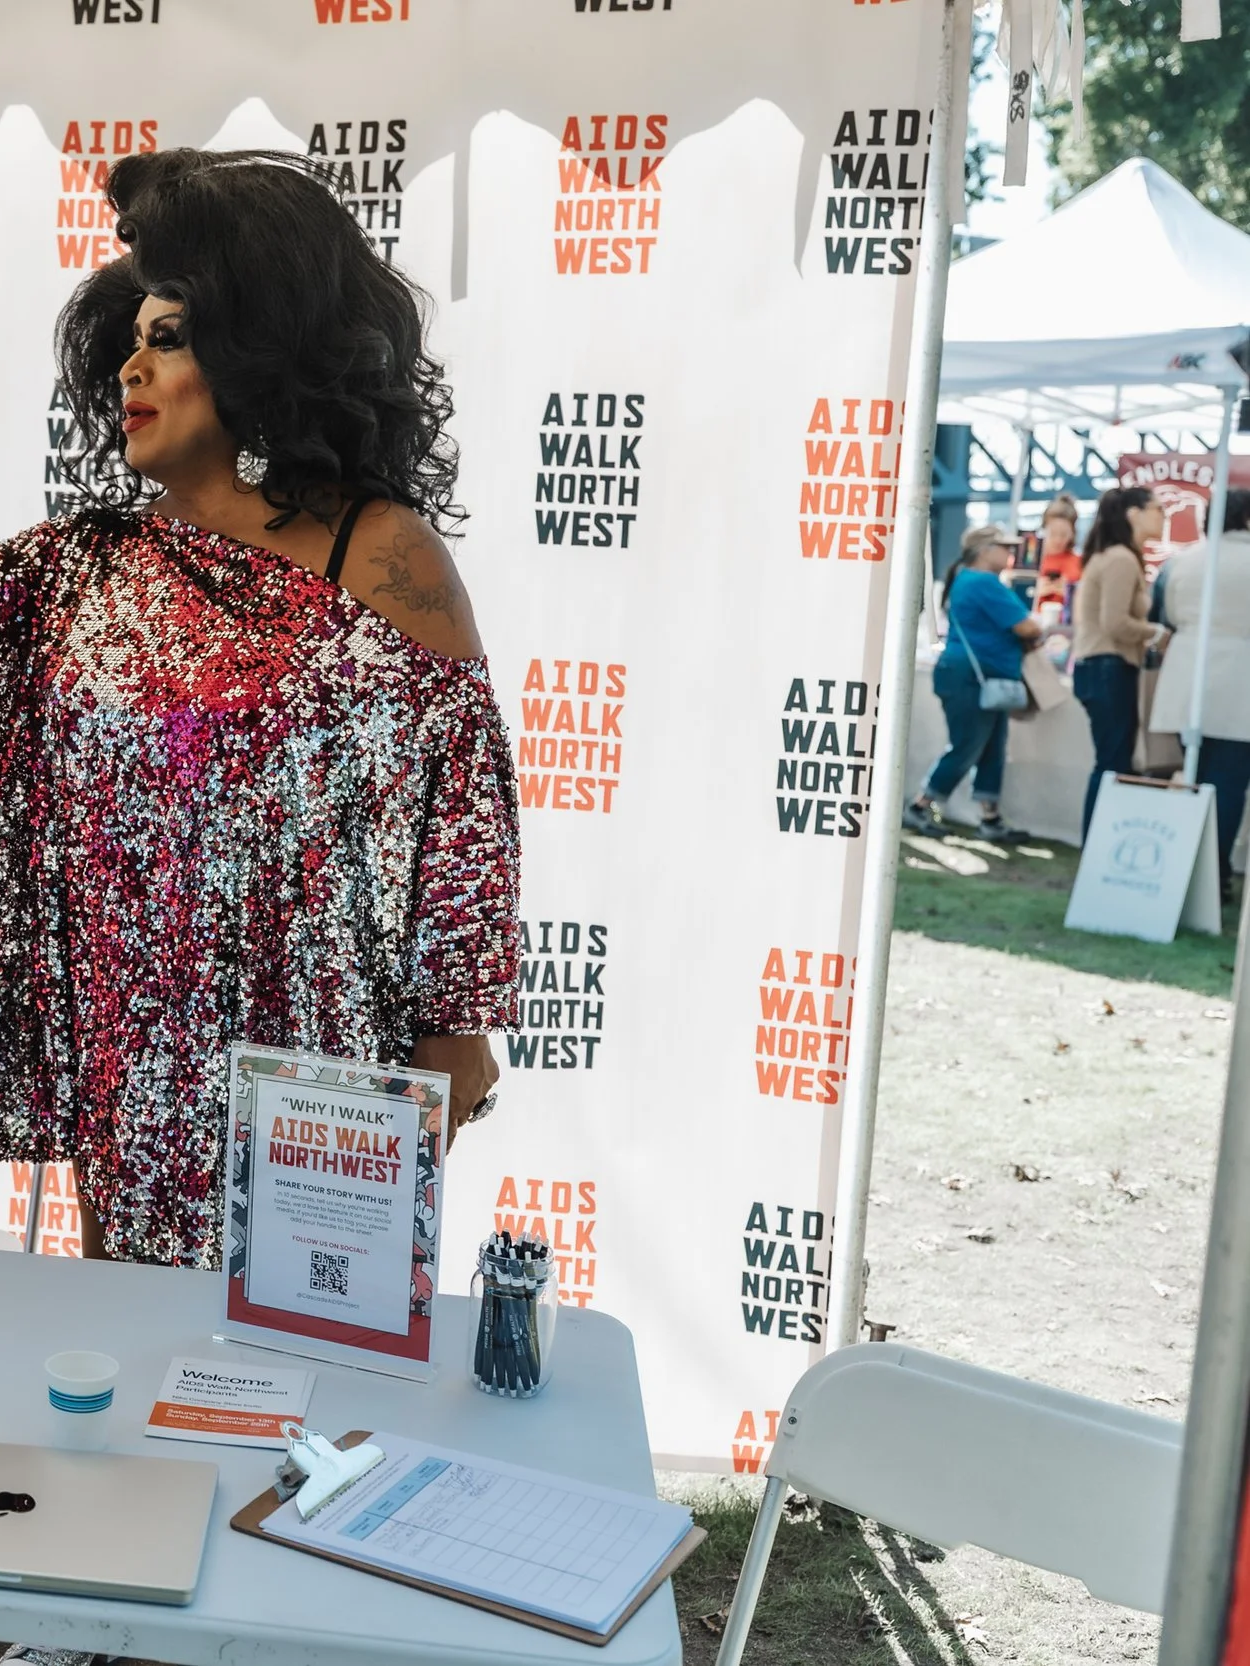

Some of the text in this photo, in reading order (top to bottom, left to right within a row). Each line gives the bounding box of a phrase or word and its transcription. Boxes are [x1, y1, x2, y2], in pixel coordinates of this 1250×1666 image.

[72, 0, 161, 24] WEST
[314, 0, 410, 23] WEST
[62, 120, 158, 153] AIDS
[308, 120, 407, 155] AIDS
[561, 114, 668, 151] AIDS
[833, 109, 934, 147] AID
[558, 157, 663, 192] WALK
[831, 153, 929, 190] WAL
[57, 198, 114, 228] NOR
[554, 198, 660, 231] NORTH
[825, 196, 925, 230] NORT
[58, 234, 124, 268] WES
[553, 236, 657, 274] WEST
[825, 237, 921, 275] WES
[542, 391, 644, 428] AIDS
[807, 398, 906, 436] AID
[539, 433, 643, 469] WALK
[805, 440, 902, 479] WAL
[536, 473, 639, 507] NORTH
[1120, 459, 1218, 490] ENDLES
[800, 482, 898, 517] NORT
[535, 510, 636, 548] WEST
[799, 521, 894, 561] WES
[523, 658, 626, 698] AIDS
[784, 678, 880, 718] AID
[521, 697, 625, 737] WALK
[519, 737, 621, 774] NORTH
[782, 719, 876, 759] WAL
[519, 772, 619, 813] WEST
[777, 759, 873, 796] NORT
[776, 797, 869, 837] WES
[762, 948, 857, 990] AID
[760, 986, 853, 1030] WAL
[507, 1035, 601, 1069] WEST
[756, 1025, 850, 1066] NORT
[756, 1060, 846, 1105] WES
[331, 1105, 334, 1116] I
[271, 1116, 401, 1160] AIDS WALK
[269, 1142, 401, 1185] NORTHWEST
[275, 1179, 392, 1206] SHARE YOUR STORY WITH US!
[334, 1201, 346, 1210] why
[366, 1206, 389, 1217] walking
[496, 1177, 596, 1215] AIDS
[290, 1216, 302, 1224] add
[302, 1218, 315, 1226] your
[316, 1220, 337, 1230] handle
[318, 1212, 328, 1220] like
[344, 1217, 354, 1226] tag
[368, 1222, 388, 1232] please
[328, 1207, 348, 1216] feature
[374, 1216, 392, 1224] social
[745, 1202, 835, 1244] AID
[292, 1235, 318, 1245] FOLLOW
[340, 1244, 370, 1255] SOCIALS:
[743, 1237, 832, 1280] WAL
[741, 1271, 829, 1311] NORT
[742, 1303, 827, 1344] WES
[176, 1386, 238, 1397] Participants
[182, 1369, 273, 1387] Welcome
[234, 1386, 288, 1396] Northwest
[734, 1411, 780, 1442] AI
